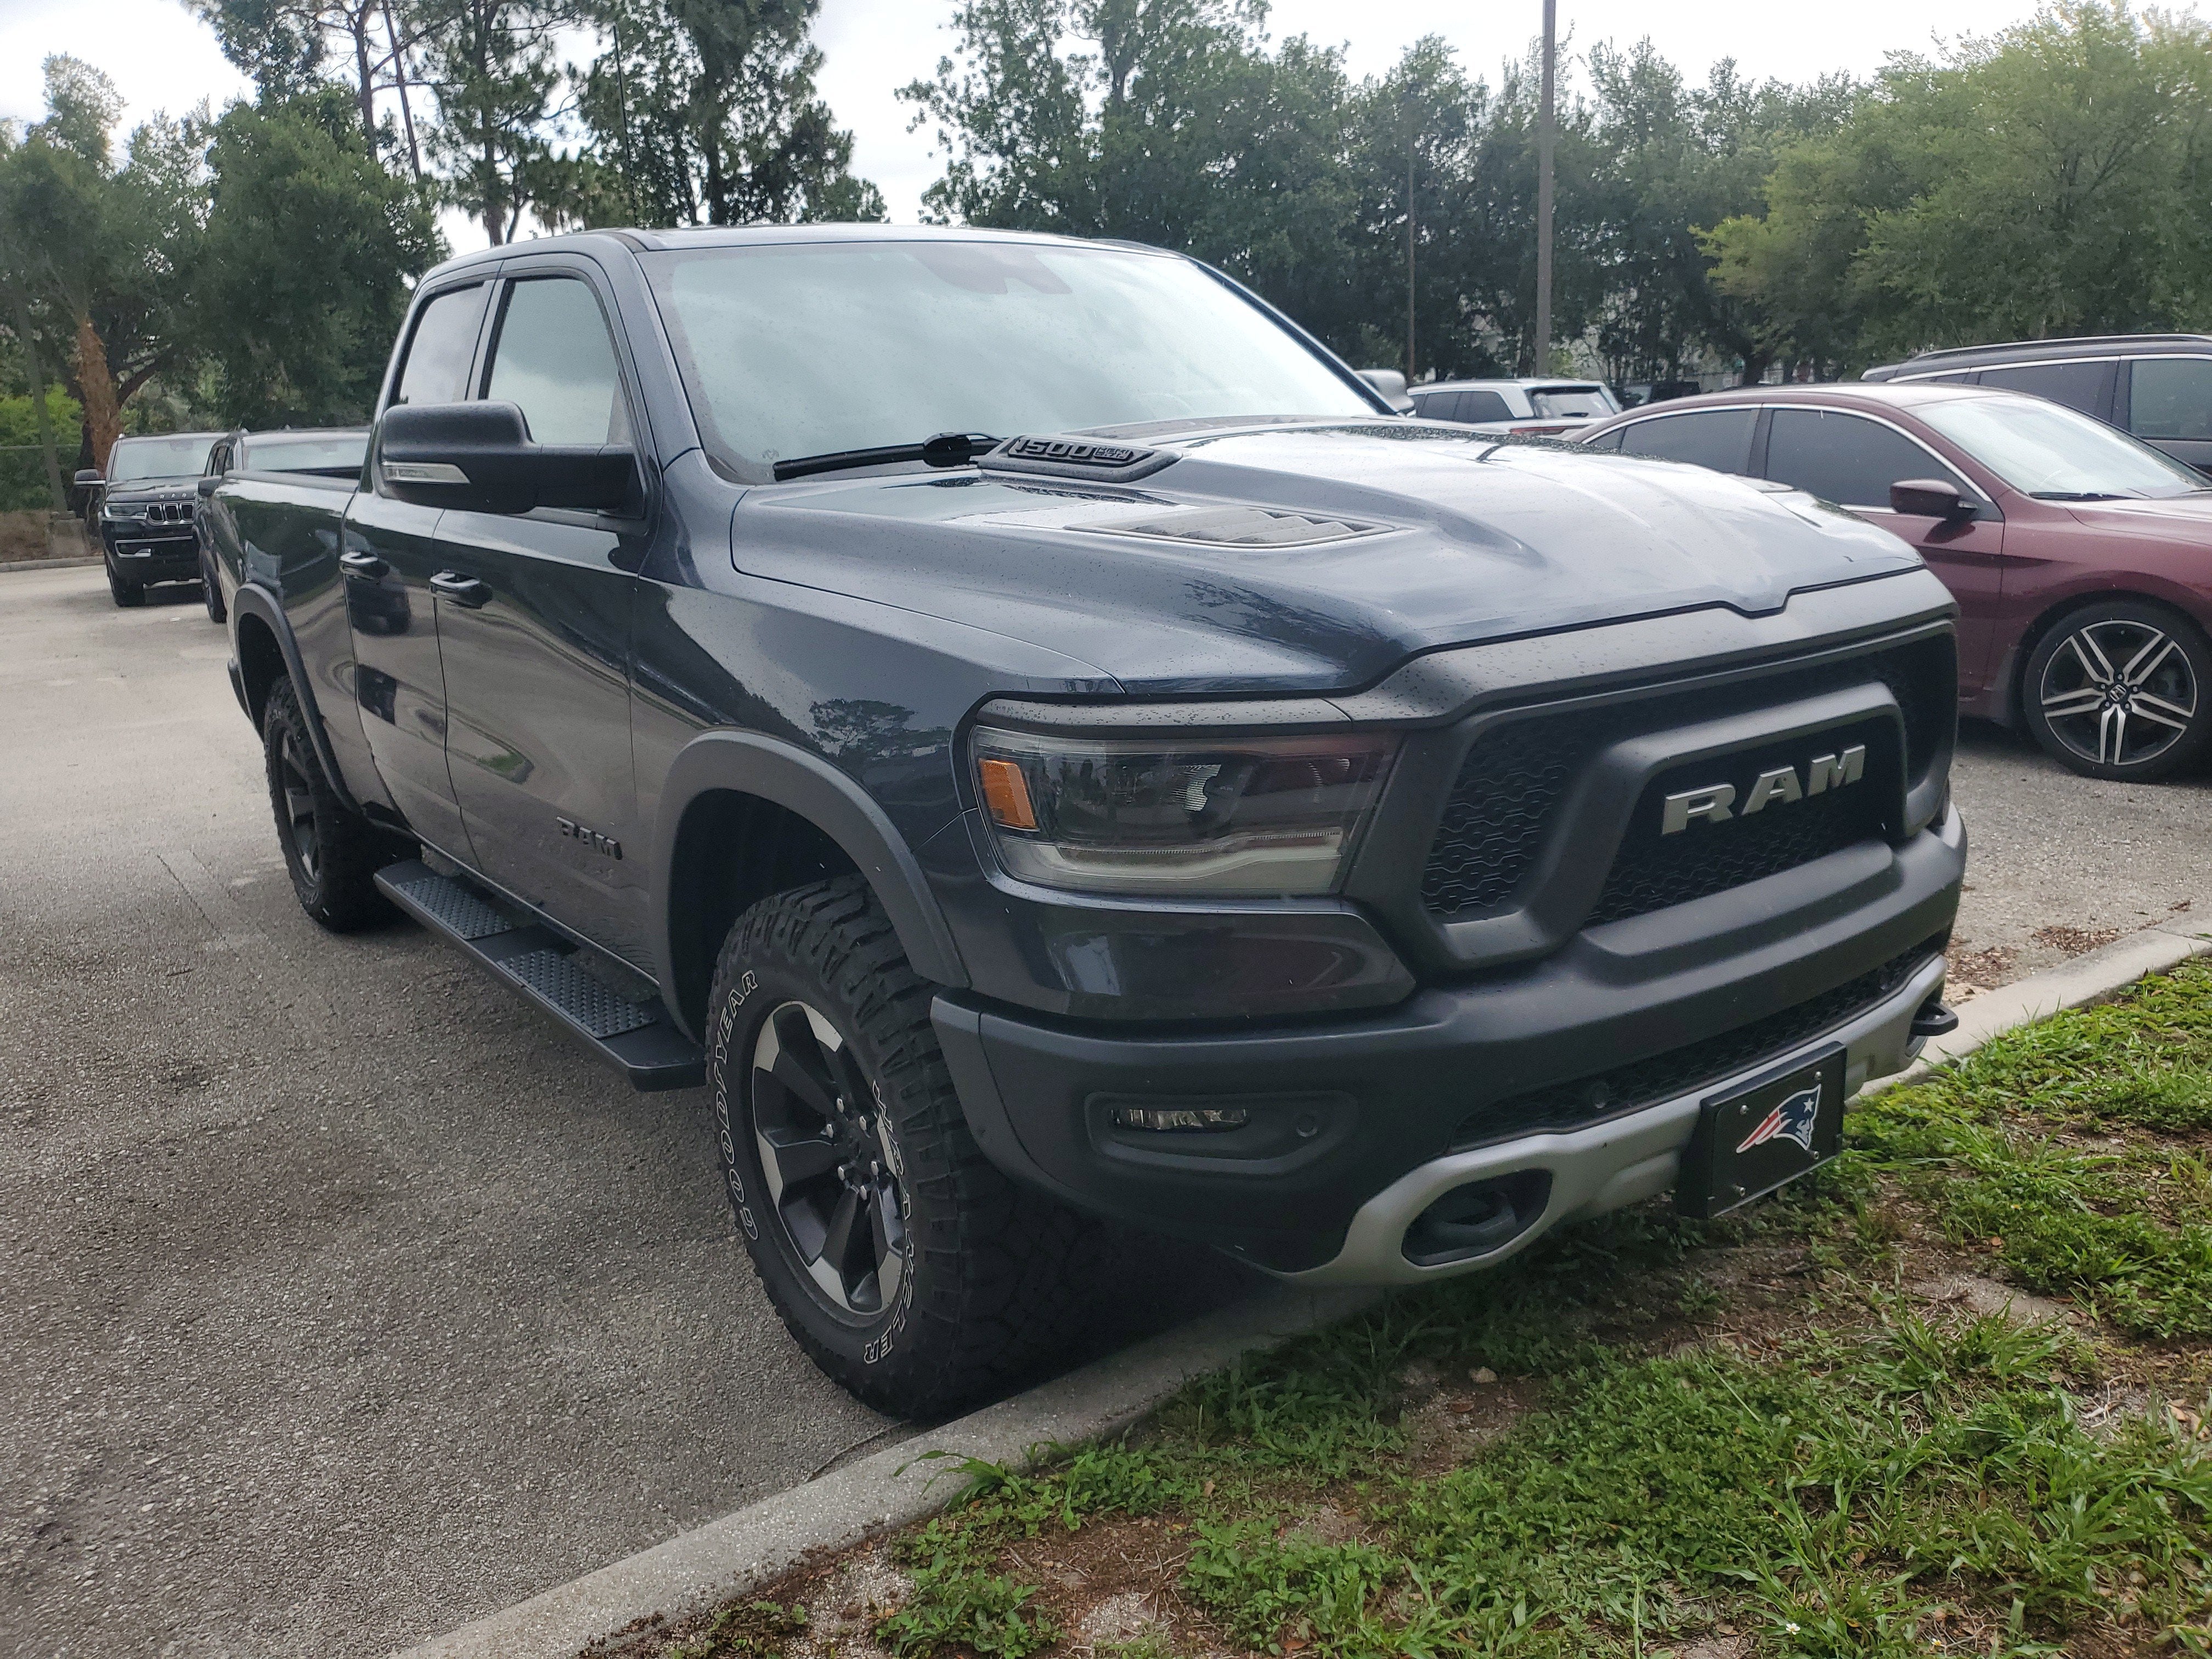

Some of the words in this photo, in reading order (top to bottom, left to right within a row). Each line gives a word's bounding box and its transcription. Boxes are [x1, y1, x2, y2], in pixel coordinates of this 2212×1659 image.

[1014, 438, 1095, 459] 1500
[1662, 744, 1865, 836] RAM
[556, 815, 623, 860] RAM
[714, 969, 759, 1240] GOODYEAR
[864, 1079, 915, 1364] WRANGLER
